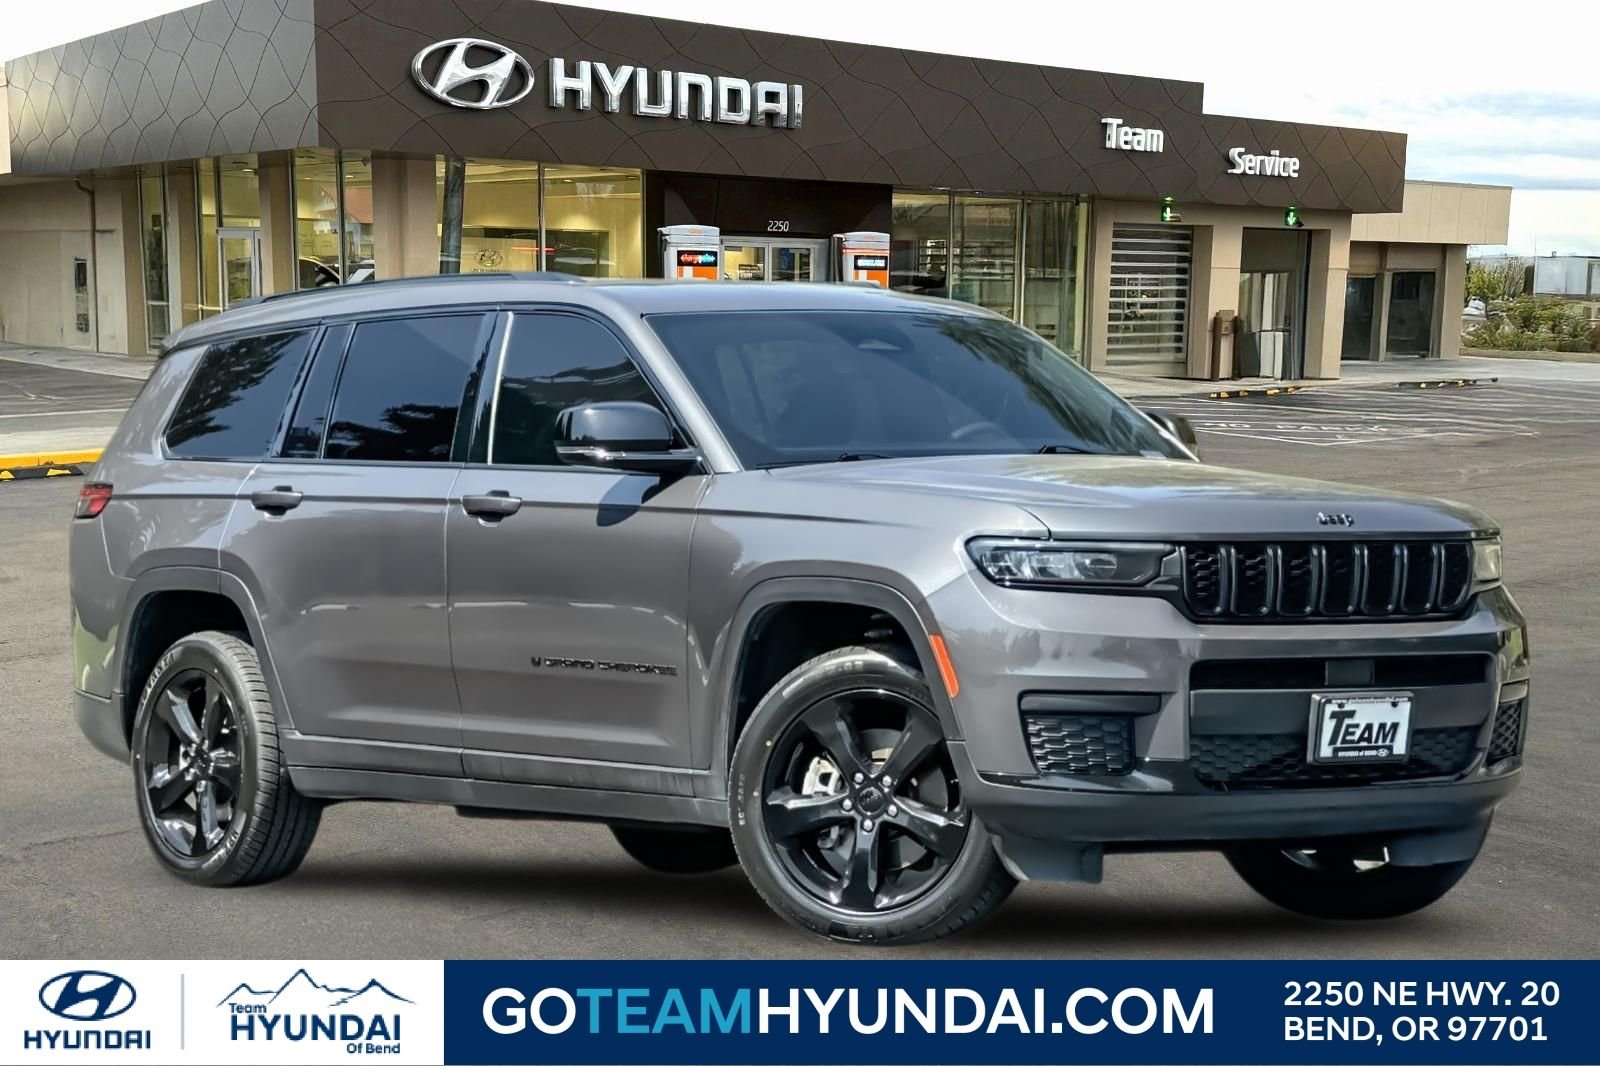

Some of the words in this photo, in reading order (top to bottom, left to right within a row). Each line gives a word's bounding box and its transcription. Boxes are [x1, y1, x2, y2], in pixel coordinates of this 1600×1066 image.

[548, 57, 804, 129] HYUNDAI
[1101, 117, 1164, 152] Team
[1227, 147, 1300, 178] Service
[767, 220, 790, 232] 2250
[1316, 511, 1355, 528] Jeep
[1327, 710, 1400, 746] TEAM
